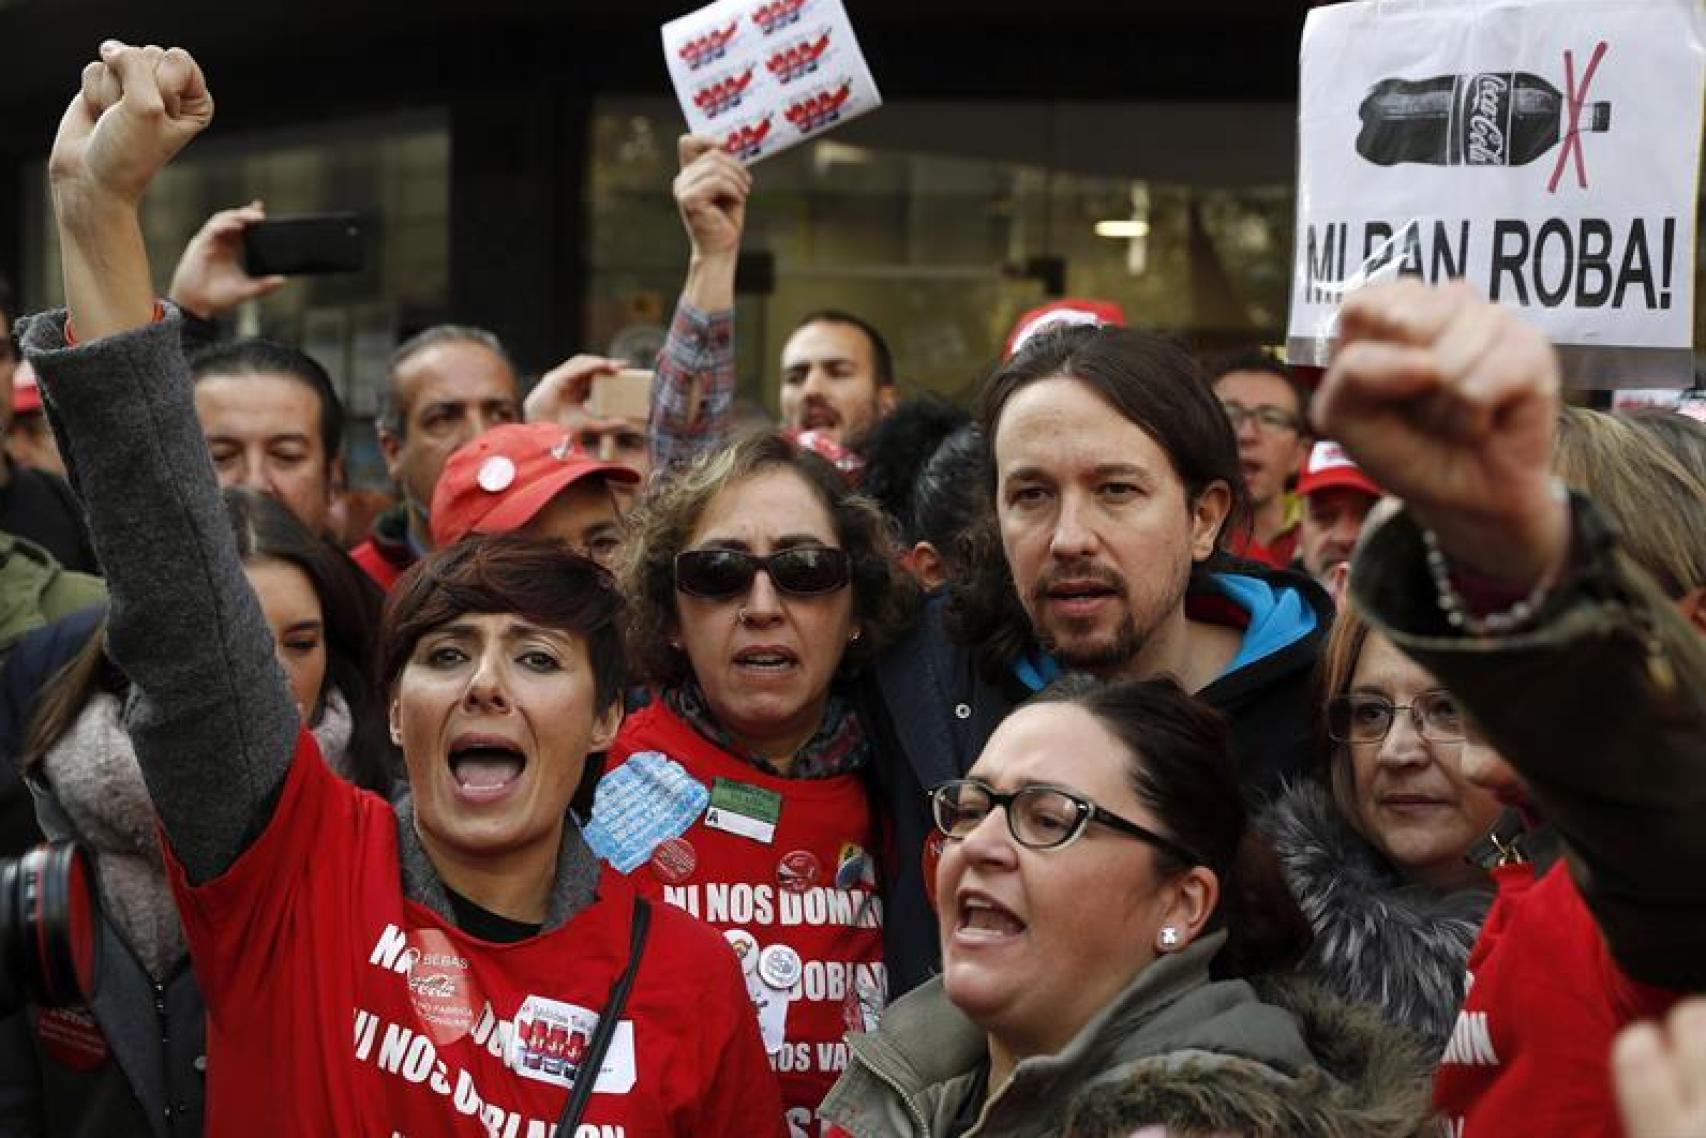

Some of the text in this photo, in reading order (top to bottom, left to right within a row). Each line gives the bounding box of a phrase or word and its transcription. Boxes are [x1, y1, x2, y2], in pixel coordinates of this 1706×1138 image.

[1305, 222, 1347, 304] MI
[1489, 217, 1676, 309] ROBA!
[706, 883, 774, 925] NOS
